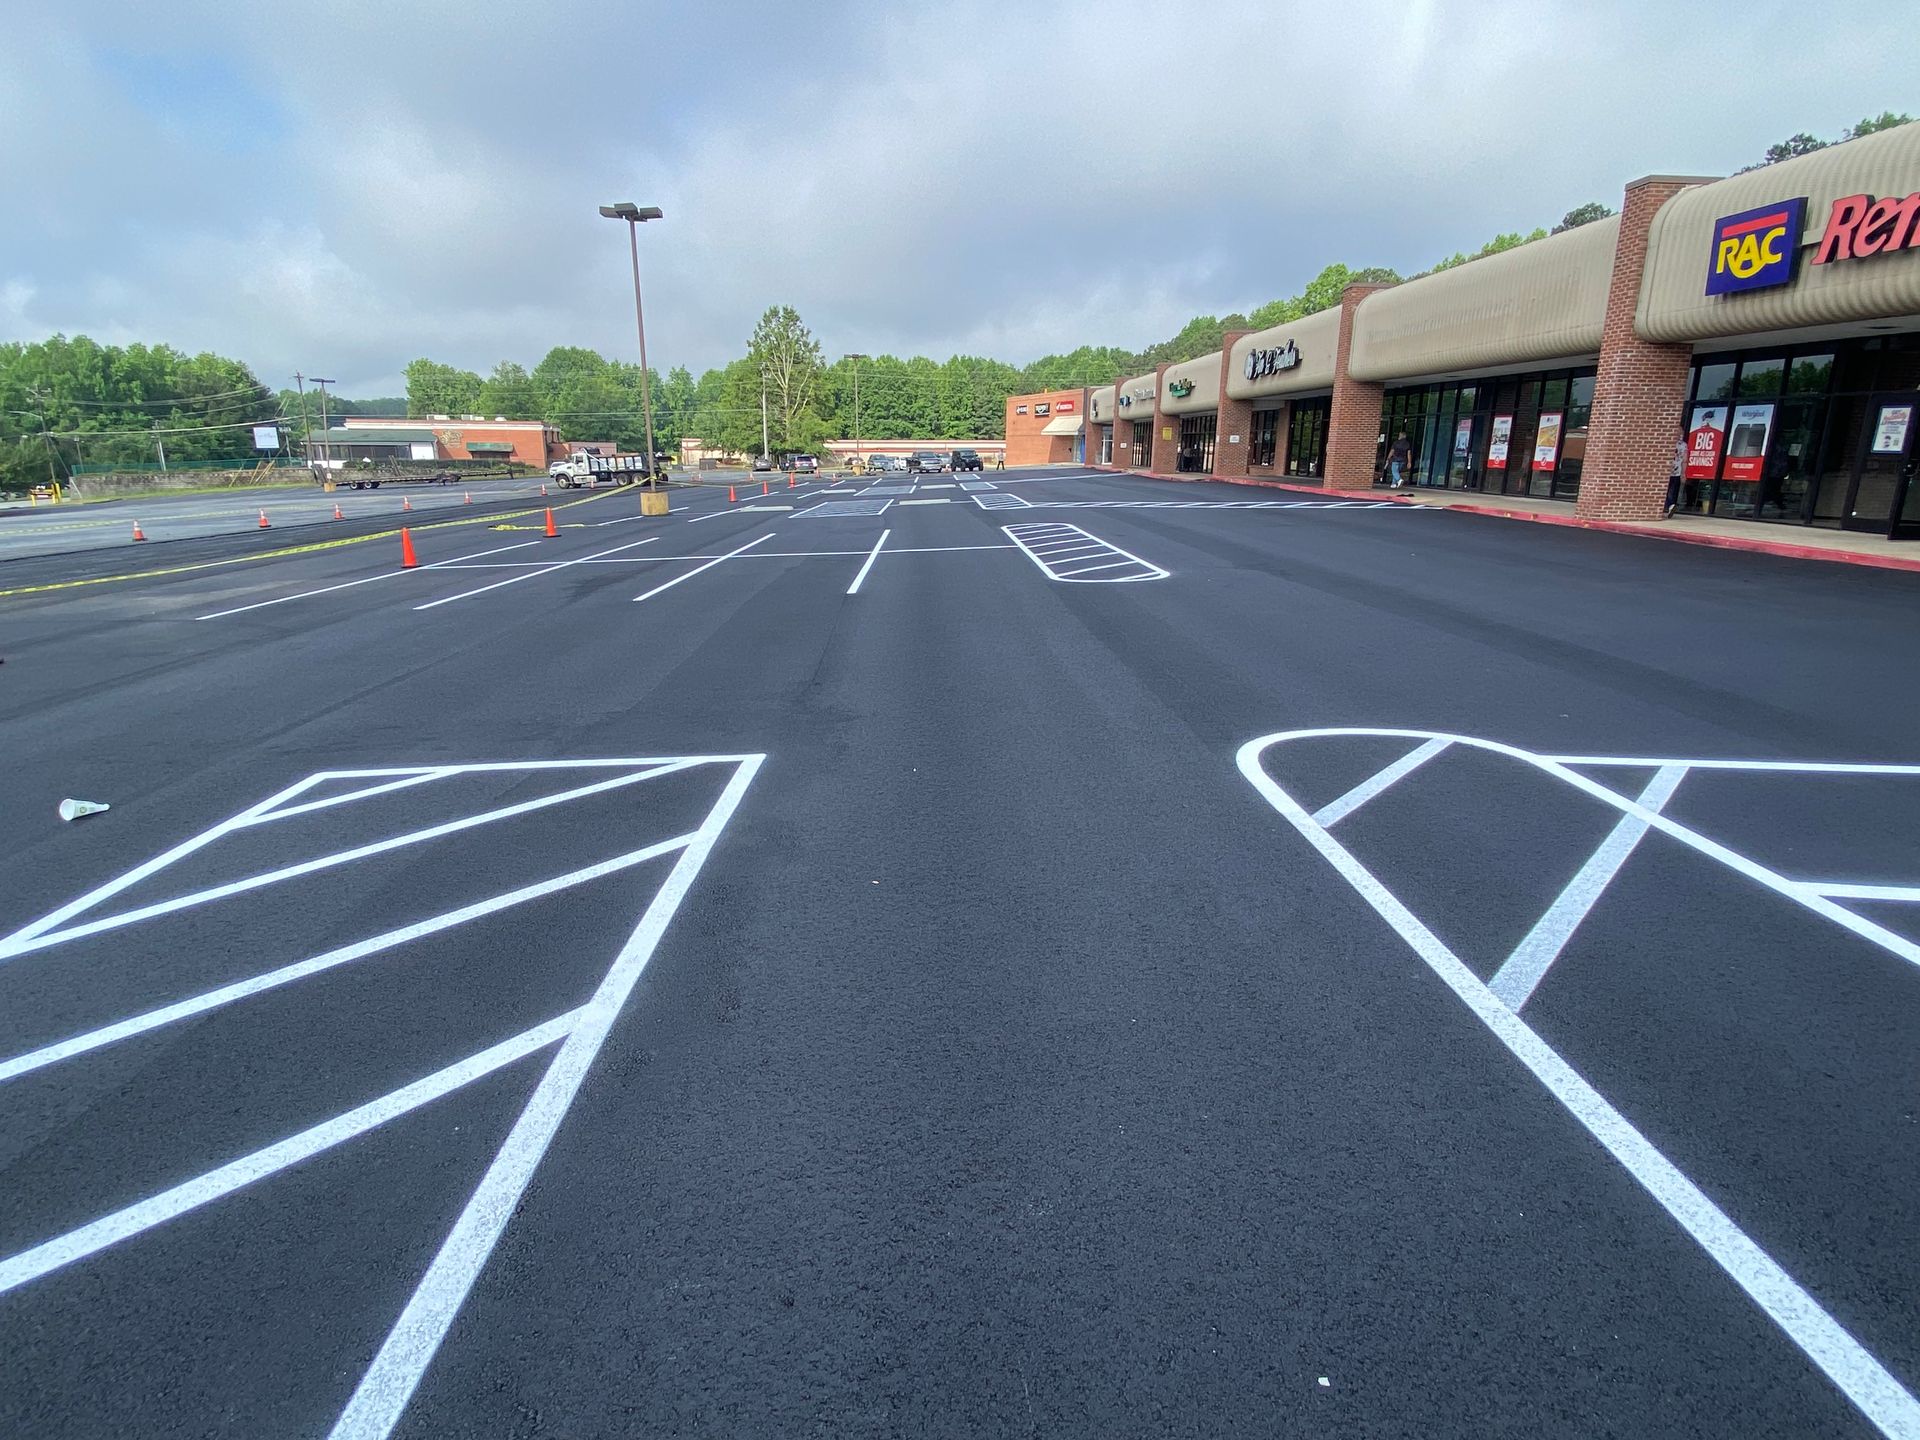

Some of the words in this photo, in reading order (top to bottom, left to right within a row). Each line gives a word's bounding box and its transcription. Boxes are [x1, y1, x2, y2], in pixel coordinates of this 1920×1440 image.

[1716, 226, 1786, 279] RAC
[1695, 432, 1715, 450] BIG
[1688, 456, 1714, 467] SAVINGS
